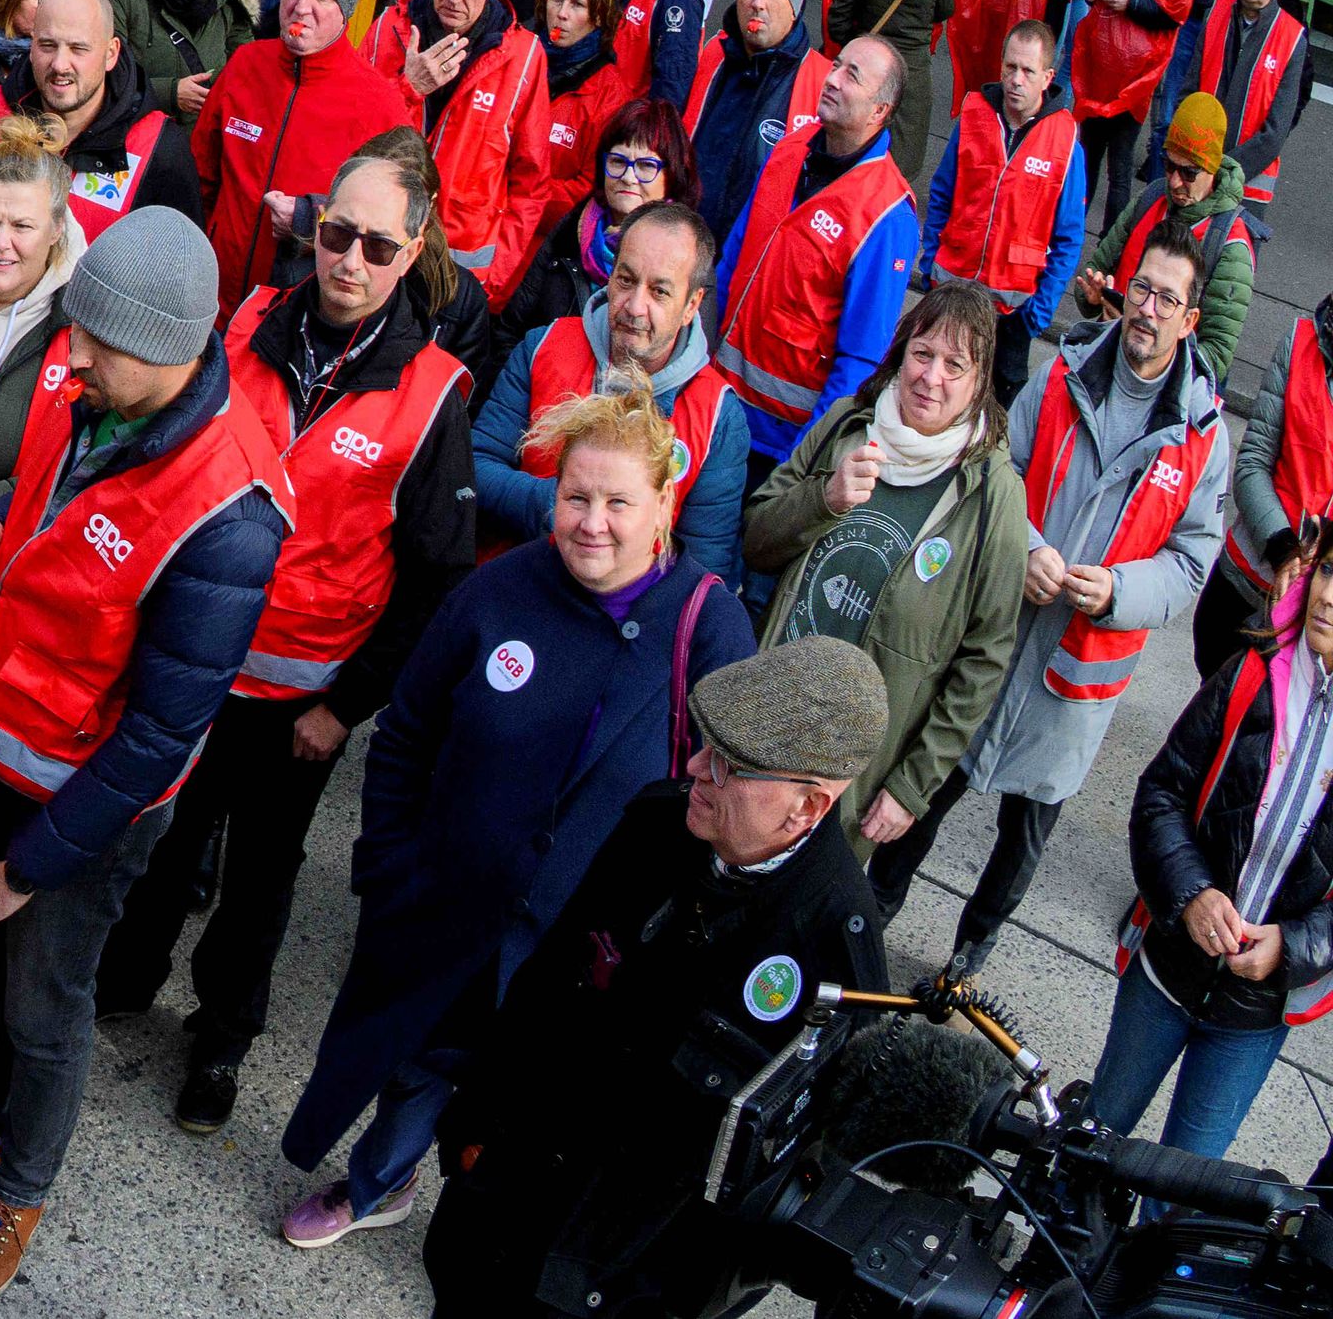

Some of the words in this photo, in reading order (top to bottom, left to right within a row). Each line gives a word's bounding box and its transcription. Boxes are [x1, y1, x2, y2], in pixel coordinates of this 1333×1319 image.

[1024, 156, 1052, 176] gpa
[810, 209, 844, 241] gpa
[330, 426, 384, 462] gpa
[83, 513, 136, 565] gpa
[804, 528, 869, 582] PEQUENA
